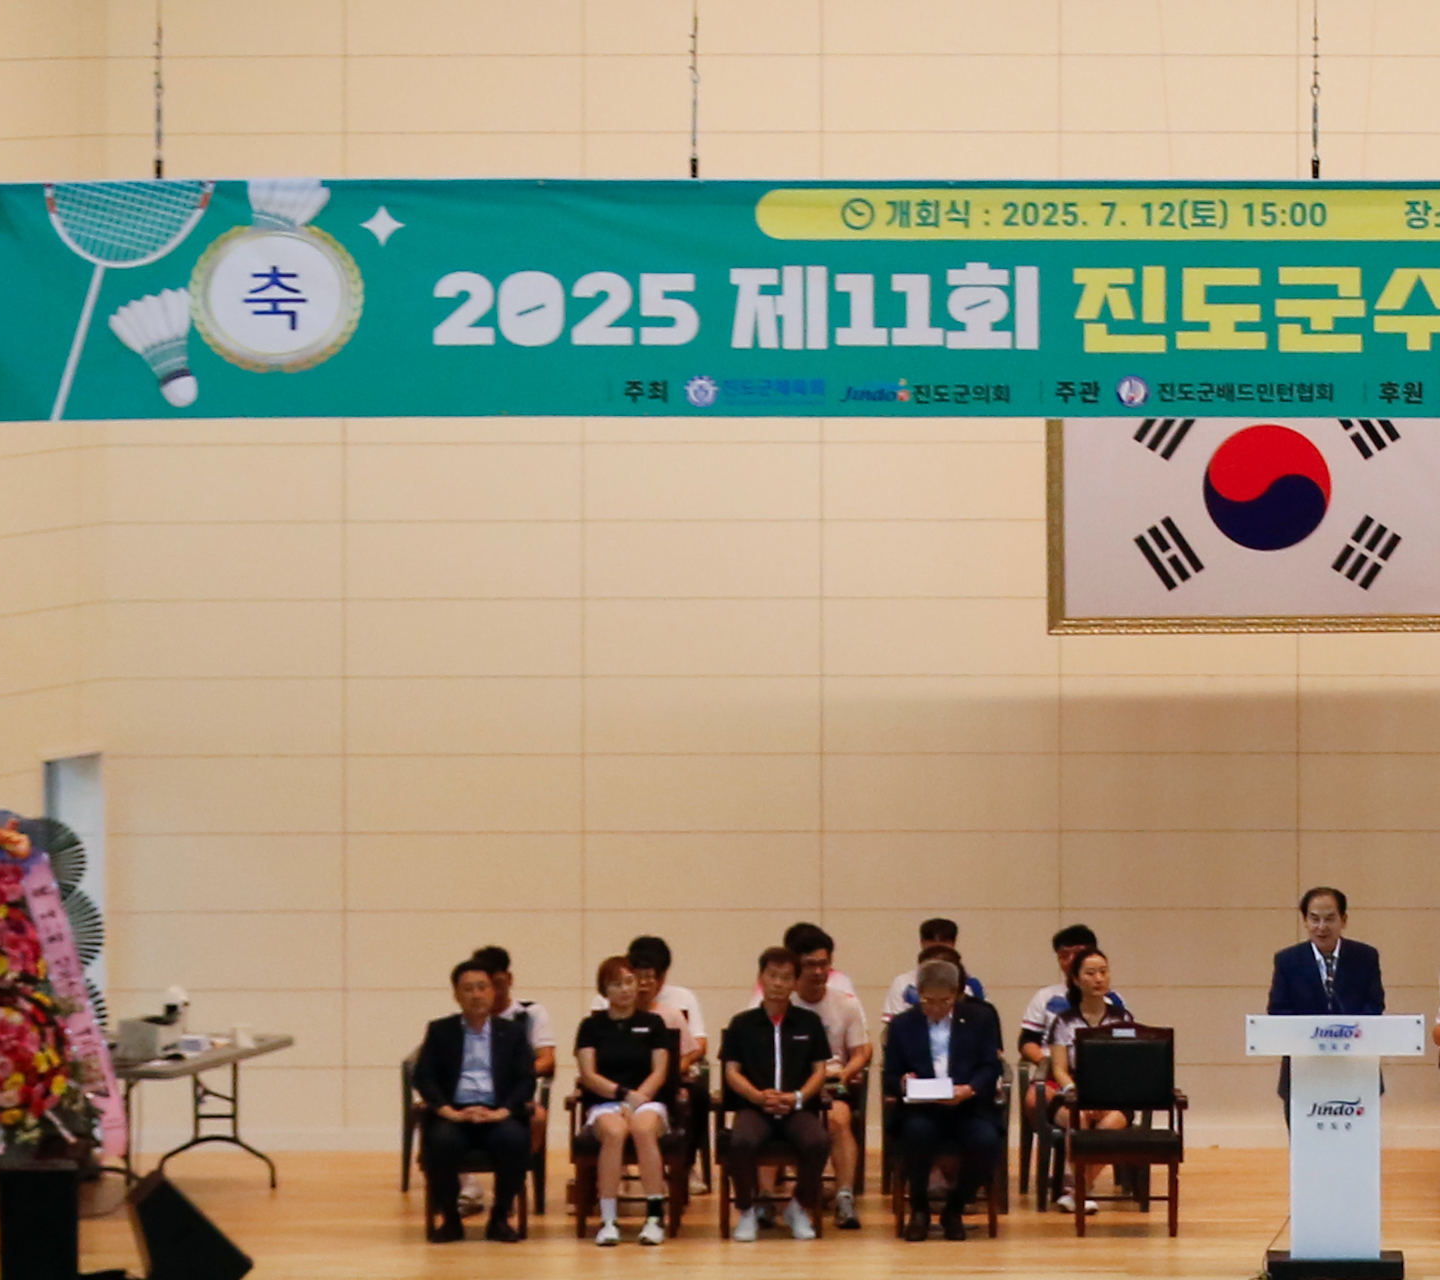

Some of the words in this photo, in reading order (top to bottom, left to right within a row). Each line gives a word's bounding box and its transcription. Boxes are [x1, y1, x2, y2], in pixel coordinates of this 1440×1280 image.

[885, 199, 970, 229] 개회식
[1001, 203, 1088, 227] 2025.
[1100, 203, 1126, 227] 7.
[1141, 201, 1229, 230] 12(토)
[1243, 204, 1328, 227] 15:00
[242, 264, 309, 331] 축
[432, 269, 701, 347] 2025
[729, 261, 1040, 351] 제11회
[623, 380, 669, 403] 주최
[912, 383, 1011, 404] 진도군의회
[1055, 381, 1100, 403] 주관
[1157, 382, 1334, 403] 진도군배드민턴협회
[1378, 381, 1423, 404] 후원
[1310, 1024, 1354, 1040] Jindo
[1307, 1102, 1355, 1117] Jindo
